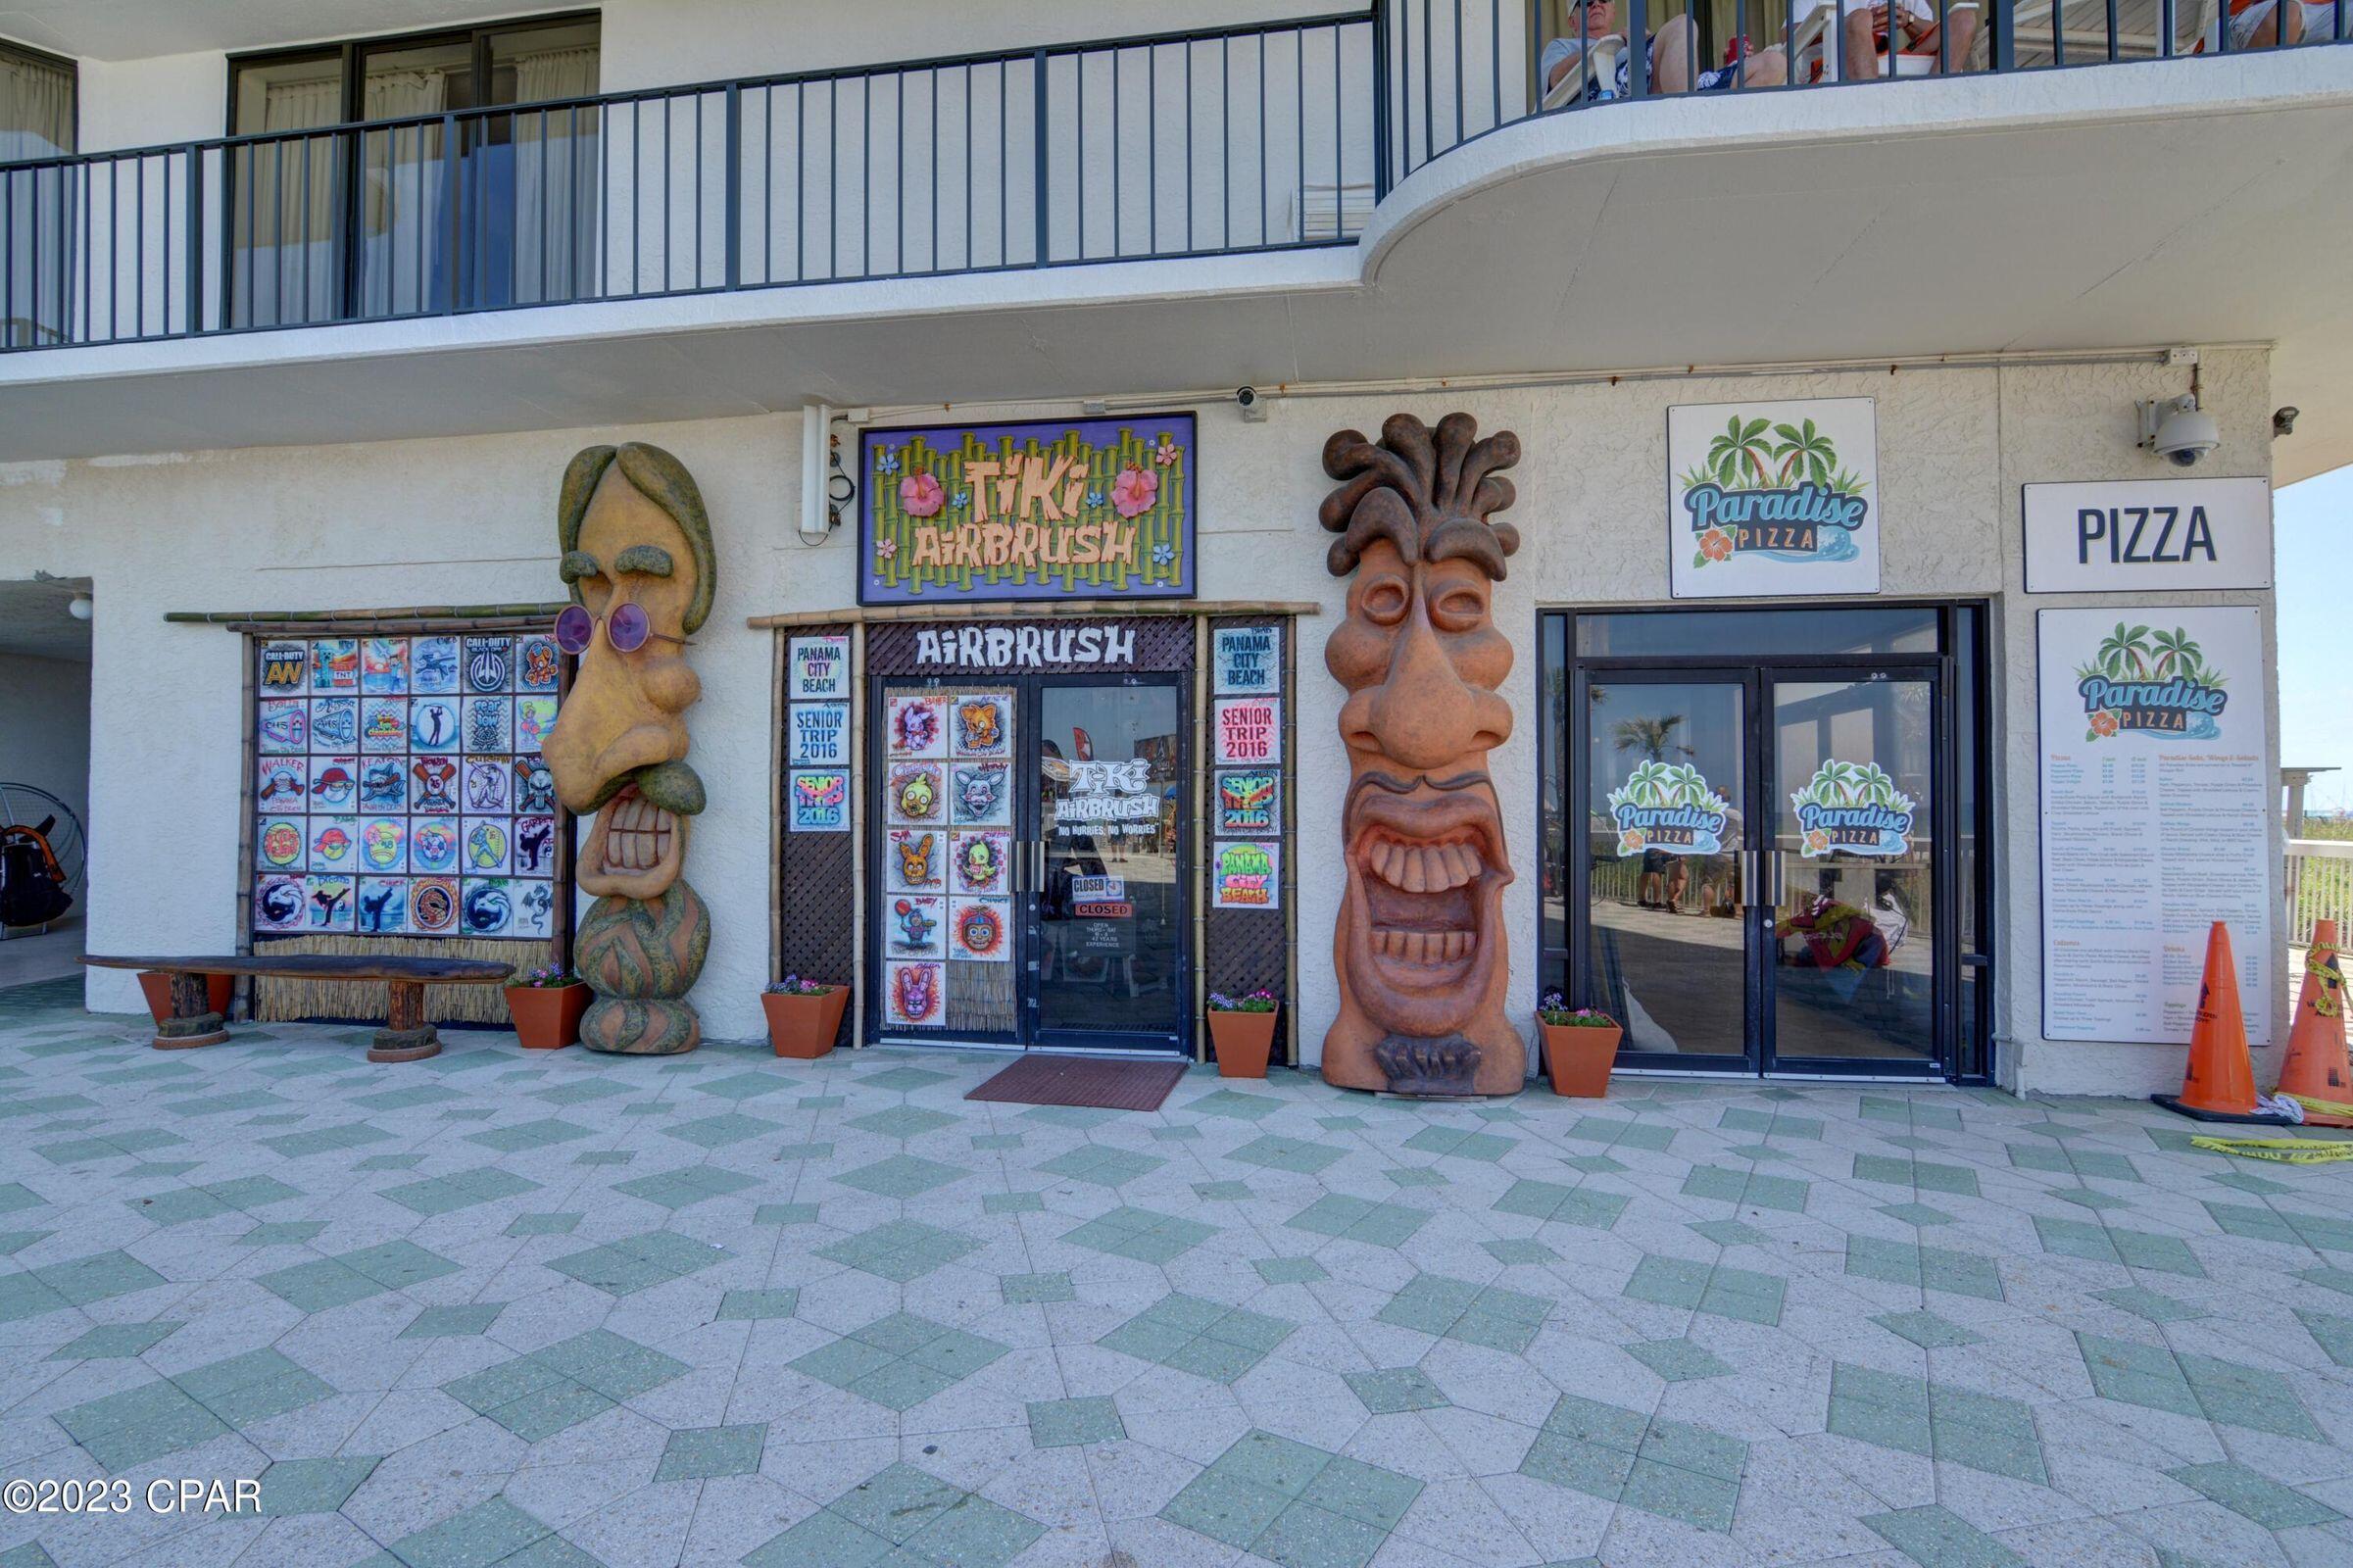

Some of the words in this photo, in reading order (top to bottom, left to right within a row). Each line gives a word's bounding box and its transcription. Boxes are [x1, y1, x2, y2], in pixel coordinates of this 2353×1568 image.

[1690, 480, 1866, 529] Paradise
[1738, 526, 1814, 551] PIZZA
[2078, 505, 2217, 565] PIZZA
[1222, 636, 1271, 652] PANAMA
[798, 648, 841, 662] PANAMA
[1233, 653, 1259, 668] CITY
[264, 662, 303, 685] AW
[808, 663, 830, 677] CITY
[1228, 669, 1265, 685] BEACH
[803, 678, 836, 693] BEACH
[2083, 678, 2226, 714] Paradise
[797, 711, 842, 729] SENIOR
[1222, 708, 1272, 726] SENIOR
[2123, 710, 2185, 731] PIZZA
[800, 729, 838, 743] TRIP
[1225, 726, 1267, 742] TRIP
[800, 743, 837, 759] 2016
[1226, 742, 1268, 759] 2016
[262, 758, 305, 775] WALKER
[796, 775, 845, 795] SENIOR
[1221, 776, 1274, 794] SENIOR
[799, 808, 840, 825] 2016
[1224, 809, 1270, 828] 2016
[1619, 804, 1723, 832] Paradise
[1801, 803, 1908, 832] Paradise
[1107, 825, 1119, 836] NO
[1646, 829, 1692, 845] PIZZA
[1832, 829, 1878, 845] PIZZA
[1221, 852, 1272, 876] PANAMA
[1074, 879, 1104, 893] CLOSED
[1220, 888, 1269, 905] BEACH
[1079, 905, 1128, 914] CLOSED
